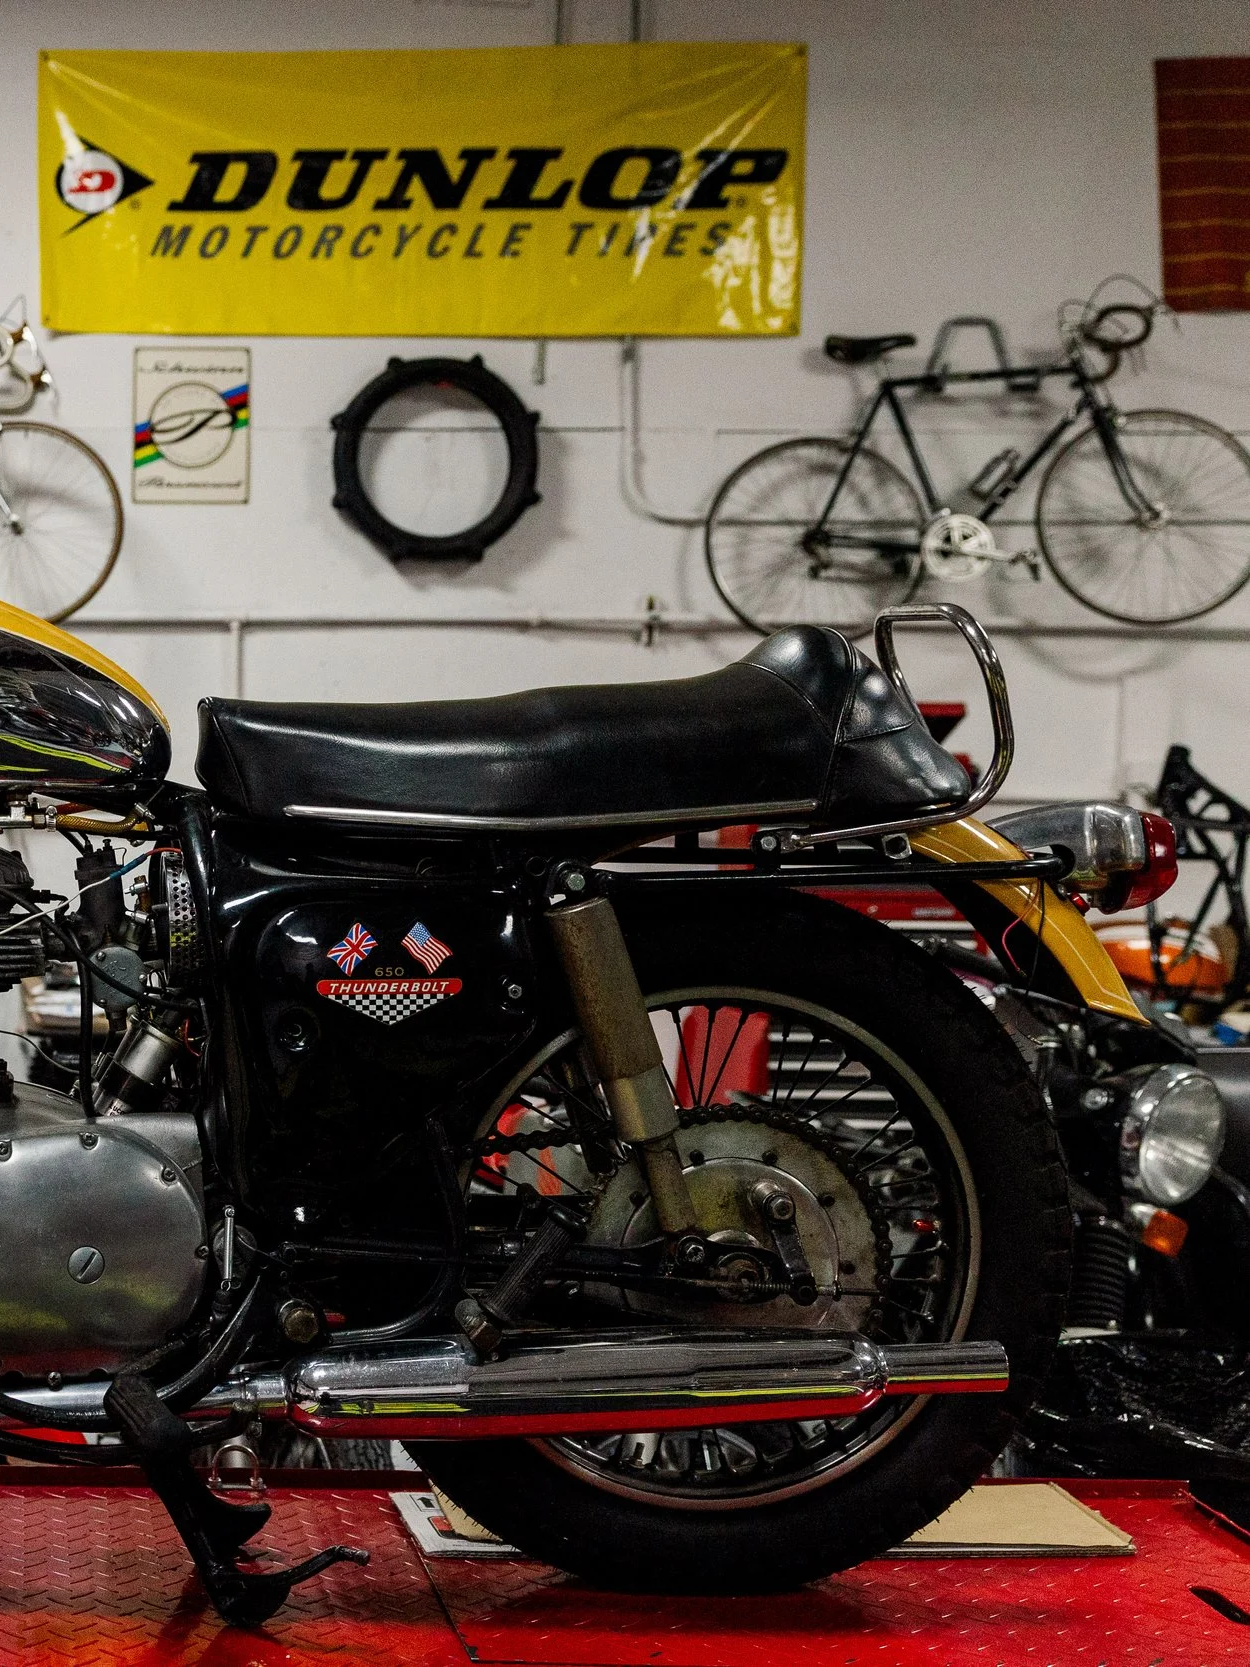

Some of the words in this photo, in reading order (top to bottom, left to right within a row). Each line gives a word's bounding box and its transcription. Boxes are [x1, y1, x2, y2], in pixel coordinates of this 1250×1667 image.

[166, 147, 788, 212] DUNLOP
[150, 222, 533, 259] MOTORCYCLE
[375, 967, 405, 977] 650
[330, 982, 450, 994] THUNDERBOLT
